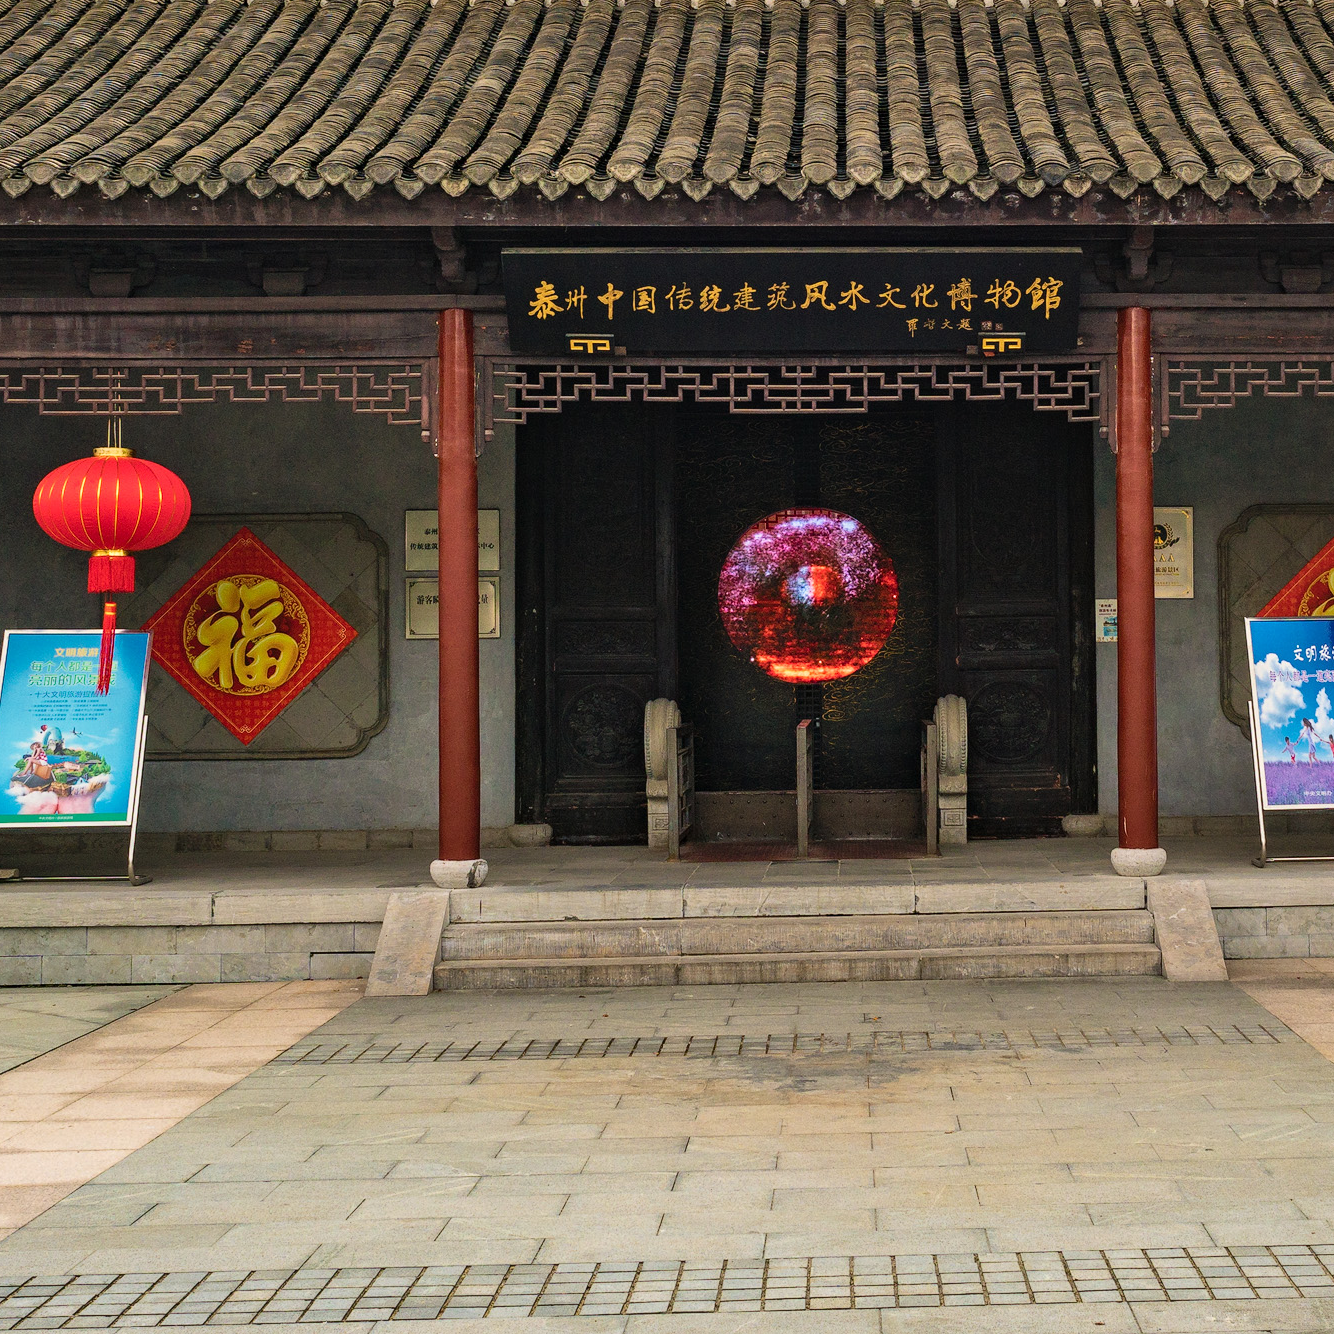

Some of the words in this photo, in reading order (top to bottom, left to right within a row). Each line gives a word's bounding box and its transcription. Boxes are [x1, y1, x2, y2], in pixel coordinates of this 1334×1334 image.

[54, 648, 99, 657] 文明旅游
[194, 580, 299, 689] 福
